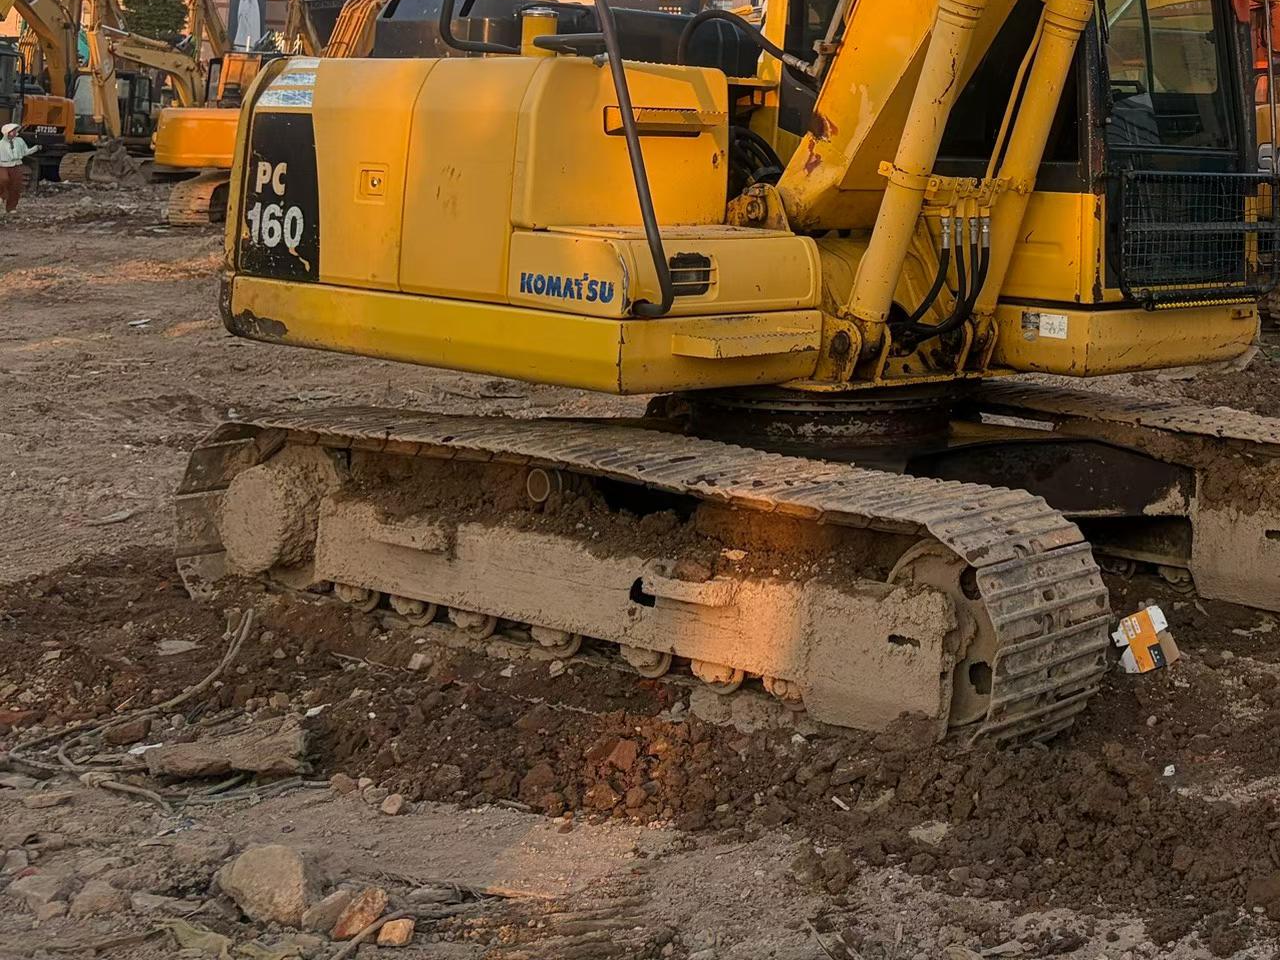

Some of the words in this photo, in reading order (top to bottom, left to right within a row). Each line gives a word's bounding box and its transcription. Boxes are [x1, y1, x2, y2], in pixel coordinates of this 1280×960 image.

[255, 160, 288, 196] PC
[248, 201, 304, 248] 160
[519, 272, 616, 304] KOMATSU
